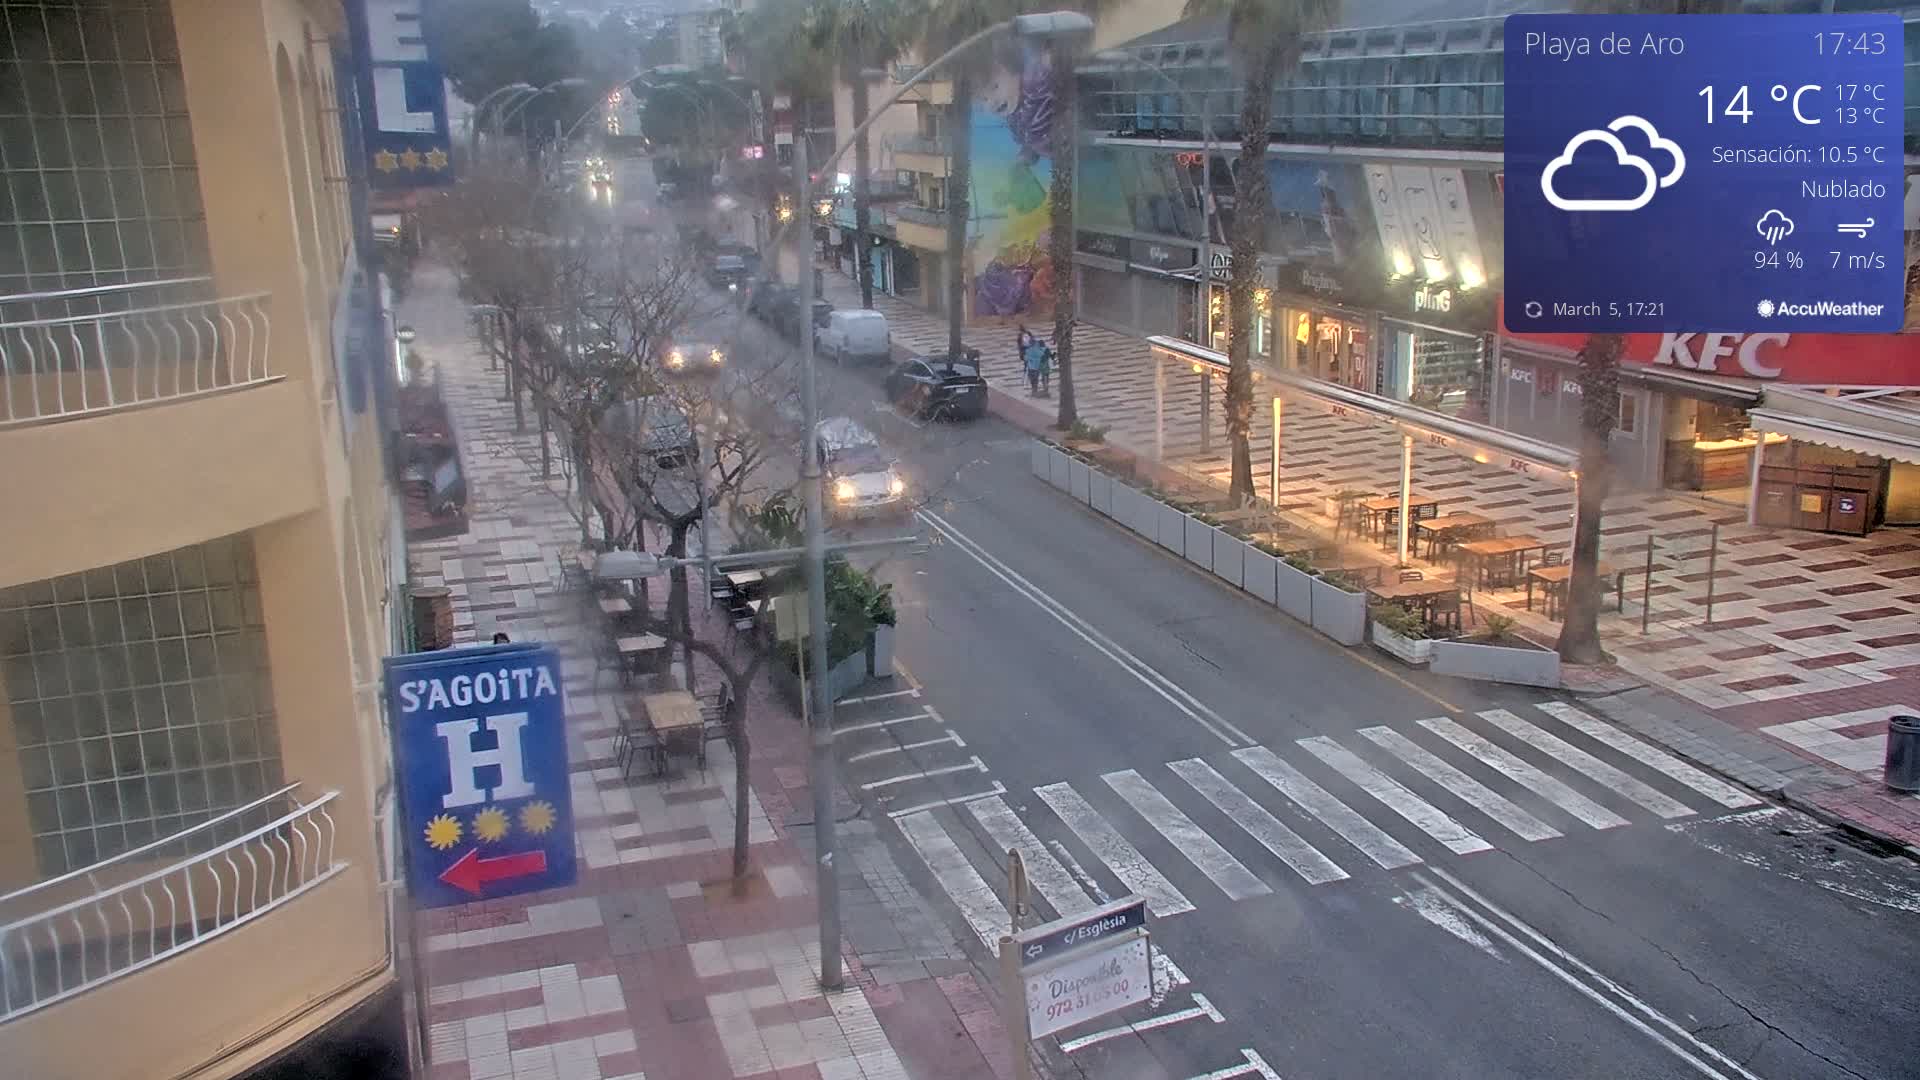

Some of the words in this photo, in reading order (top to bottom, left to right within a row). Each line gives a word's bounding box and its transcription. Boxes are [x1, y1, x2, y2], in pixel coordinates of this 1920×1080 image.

[1653, 333, 1792, 378] KFC
[436, 711, 536, 809] H
[1048, 957, 1124, 999] Disponble
[1046, 998, 1073, 1021] 972
